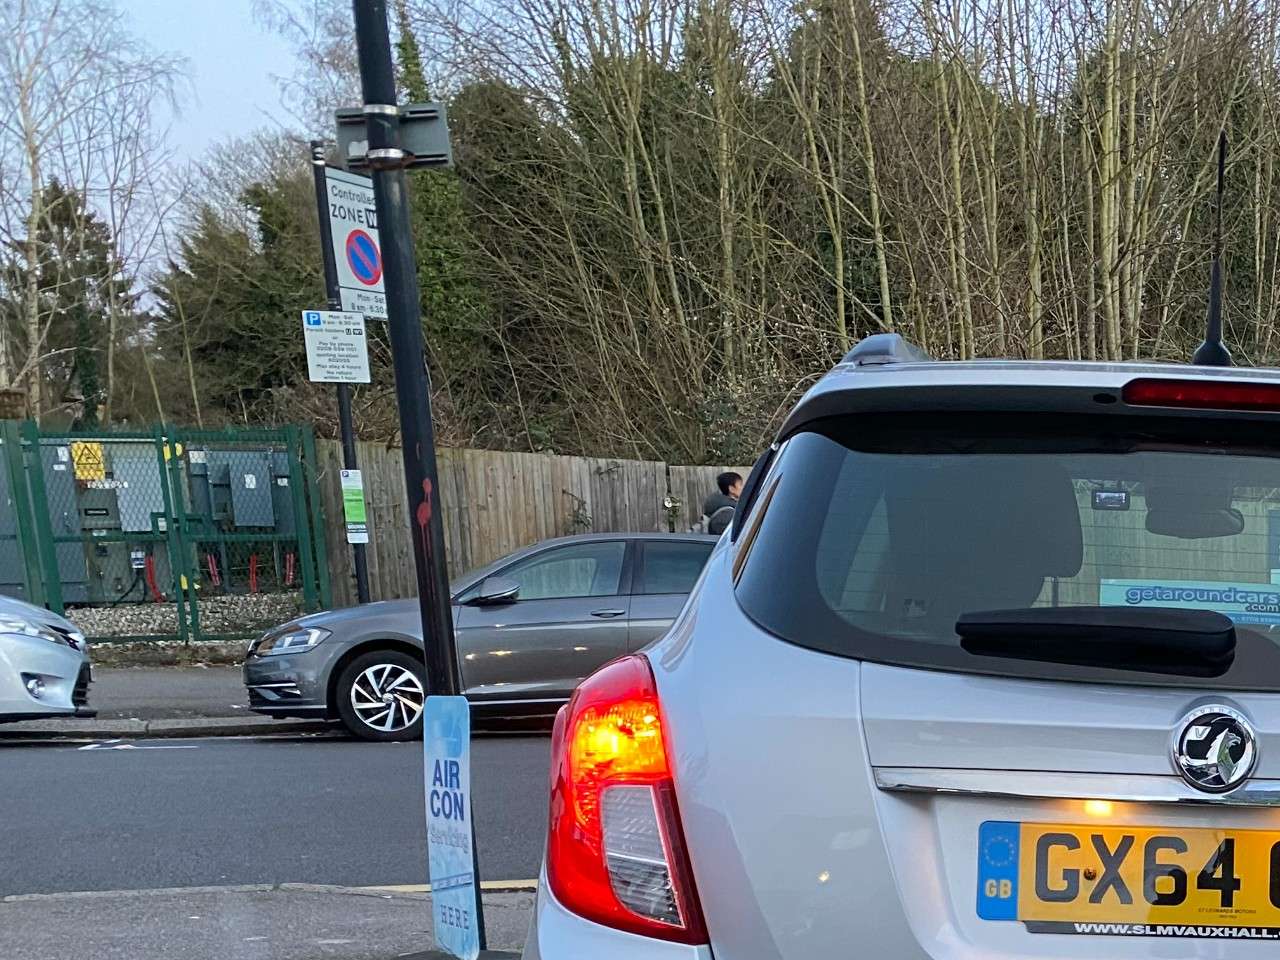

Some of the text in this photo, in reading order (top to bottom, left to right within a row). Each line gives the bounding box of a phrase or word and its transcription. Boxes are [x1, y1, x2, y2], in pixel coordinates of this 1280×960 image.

[331, 203, 364, 224] ZONE
[1127, 586, 1279, 604] getaroundcars
[1246, 603, 1280, 613] .com
[432, 758, 460, 789] AIR
[430, 789, 464, 821] CON
[1035, 832, 1241, 908] GX64
[984, 878, 1013, 899] GB
[440, 903, 470, 930] HERE
